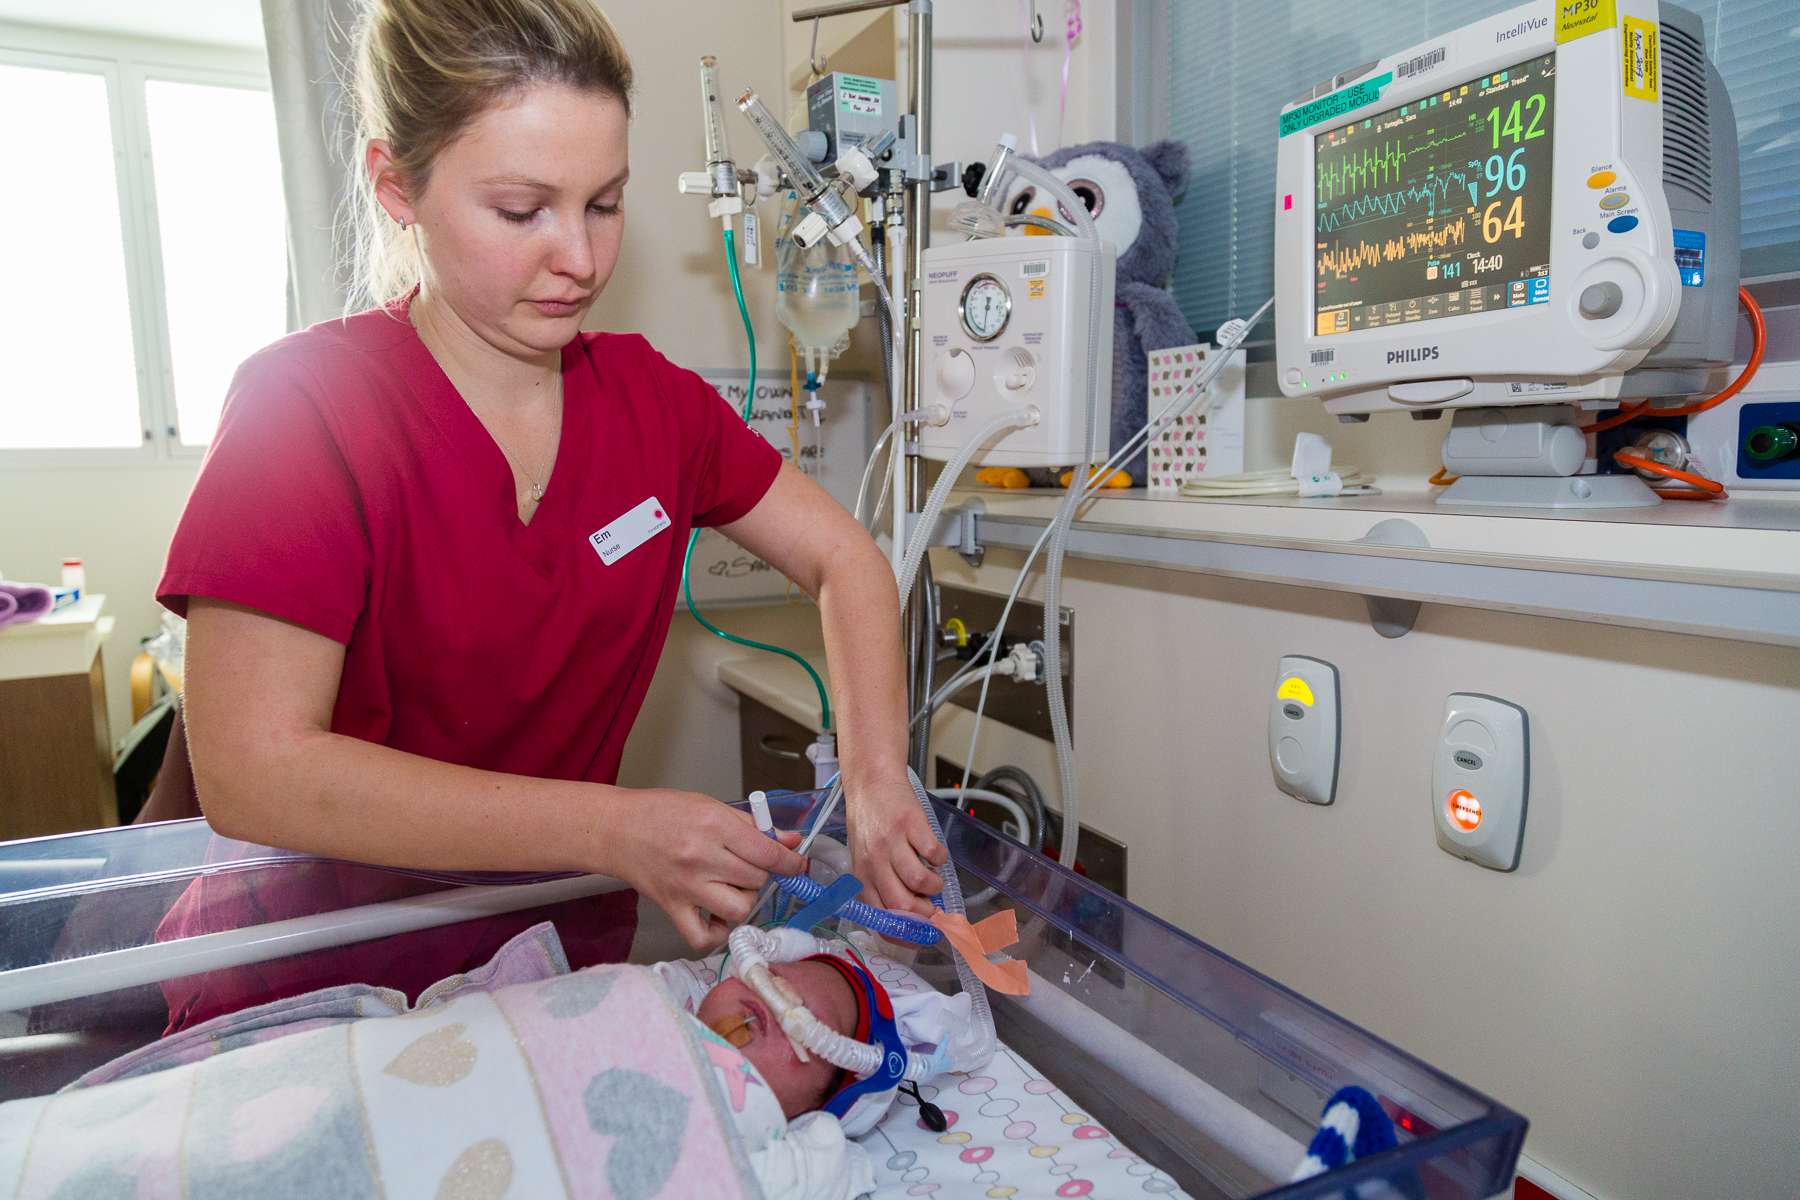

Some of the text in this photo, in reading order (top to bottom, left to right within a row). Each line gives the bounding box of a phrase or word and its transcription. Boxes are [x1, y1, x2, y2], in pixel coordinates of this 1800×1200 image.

[1562, 0, 1598, 18] MP30
[1496, 16, 1548, 43] IntelliVue
[1302, 95, 1339, 116] MONITOR
[1347, 85, 1366, 98] USE
[1303, 102, 1347, 127] UPGRADED
[1487, 93, 1546, 149] 142
[1485, 147, 1526, 198] 96
[1591, 164, 1613, 173] Silence
[1605, 185, 1627, 194] Alarms
[1482, 195, 1526, 244] 64
[1616, 207, 1639, 217] Screen
[1442, 262, 1461, 279] 141
[1472, 254, 1503, 274] 14:40
[1387, 346, 1440, 364] PHILIPS
[593, 530, 611, 545] Em
[602, 544, 621, 557] Nurse
[1456, 756, 1477, 766] CANCEL
